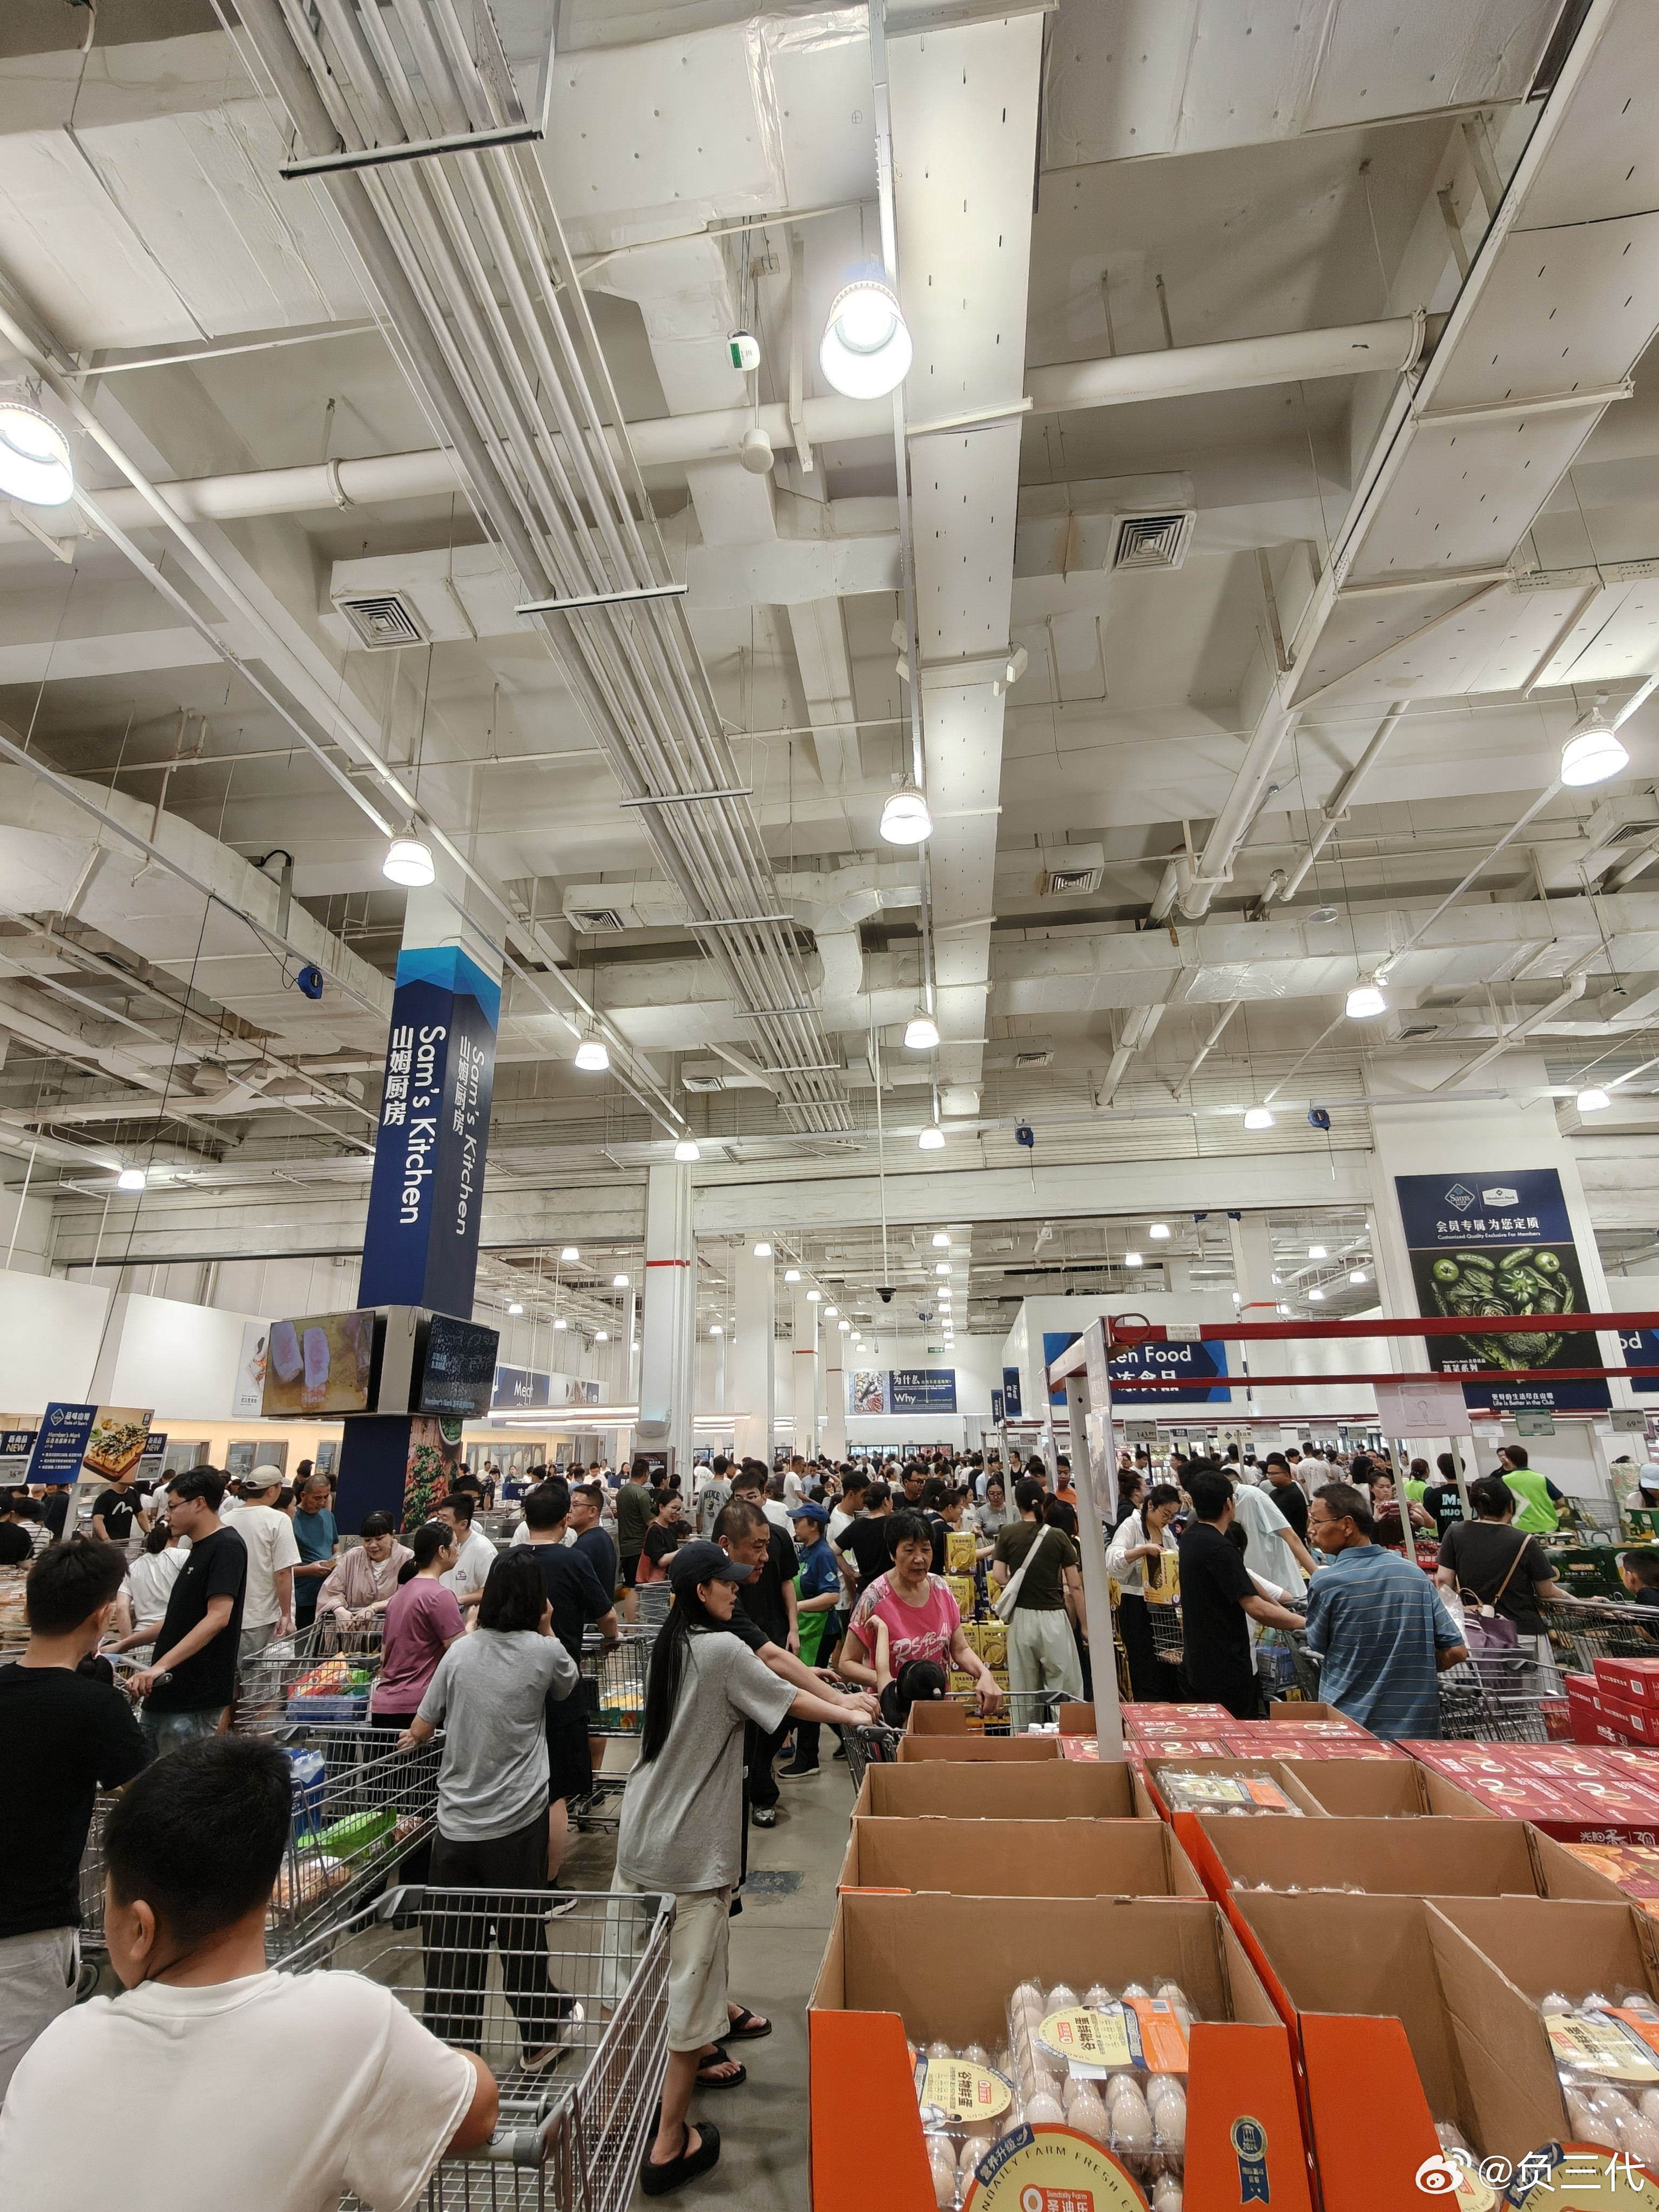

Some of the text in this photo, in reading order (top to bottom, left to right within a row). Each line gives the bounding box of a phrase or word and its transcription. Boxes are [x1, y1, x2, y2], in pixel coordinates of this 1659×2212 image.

[382, 1025, 414, 1127] 山姆厨房
[452, 1035, 471, 1136] 山姆厨房
[400, 1026, 446, 1224] Sam's Kitchen
[455, 1045, 484, 1236] Sam's Kitchen
[1436, 1217, 1539, 1232] 会员专属 为您定质
[1145, 1345, 1191, 1363] Food
[893, 1375, 920, 1385] 为什么
[1109, 1370, 1179, 1392] 冻食品
[894, 1393, 916, 1405] Why
[6, 1444, 26, 1452] NEW
[704, 1490, 720, 1501] NIKE
[1075, 2017, 1095, 2051] 谷物鲜蛋
[958, 2071, 972, 2108] 谷物鲜蛋
[1075, 2152, 1118, 2193] FRESH
